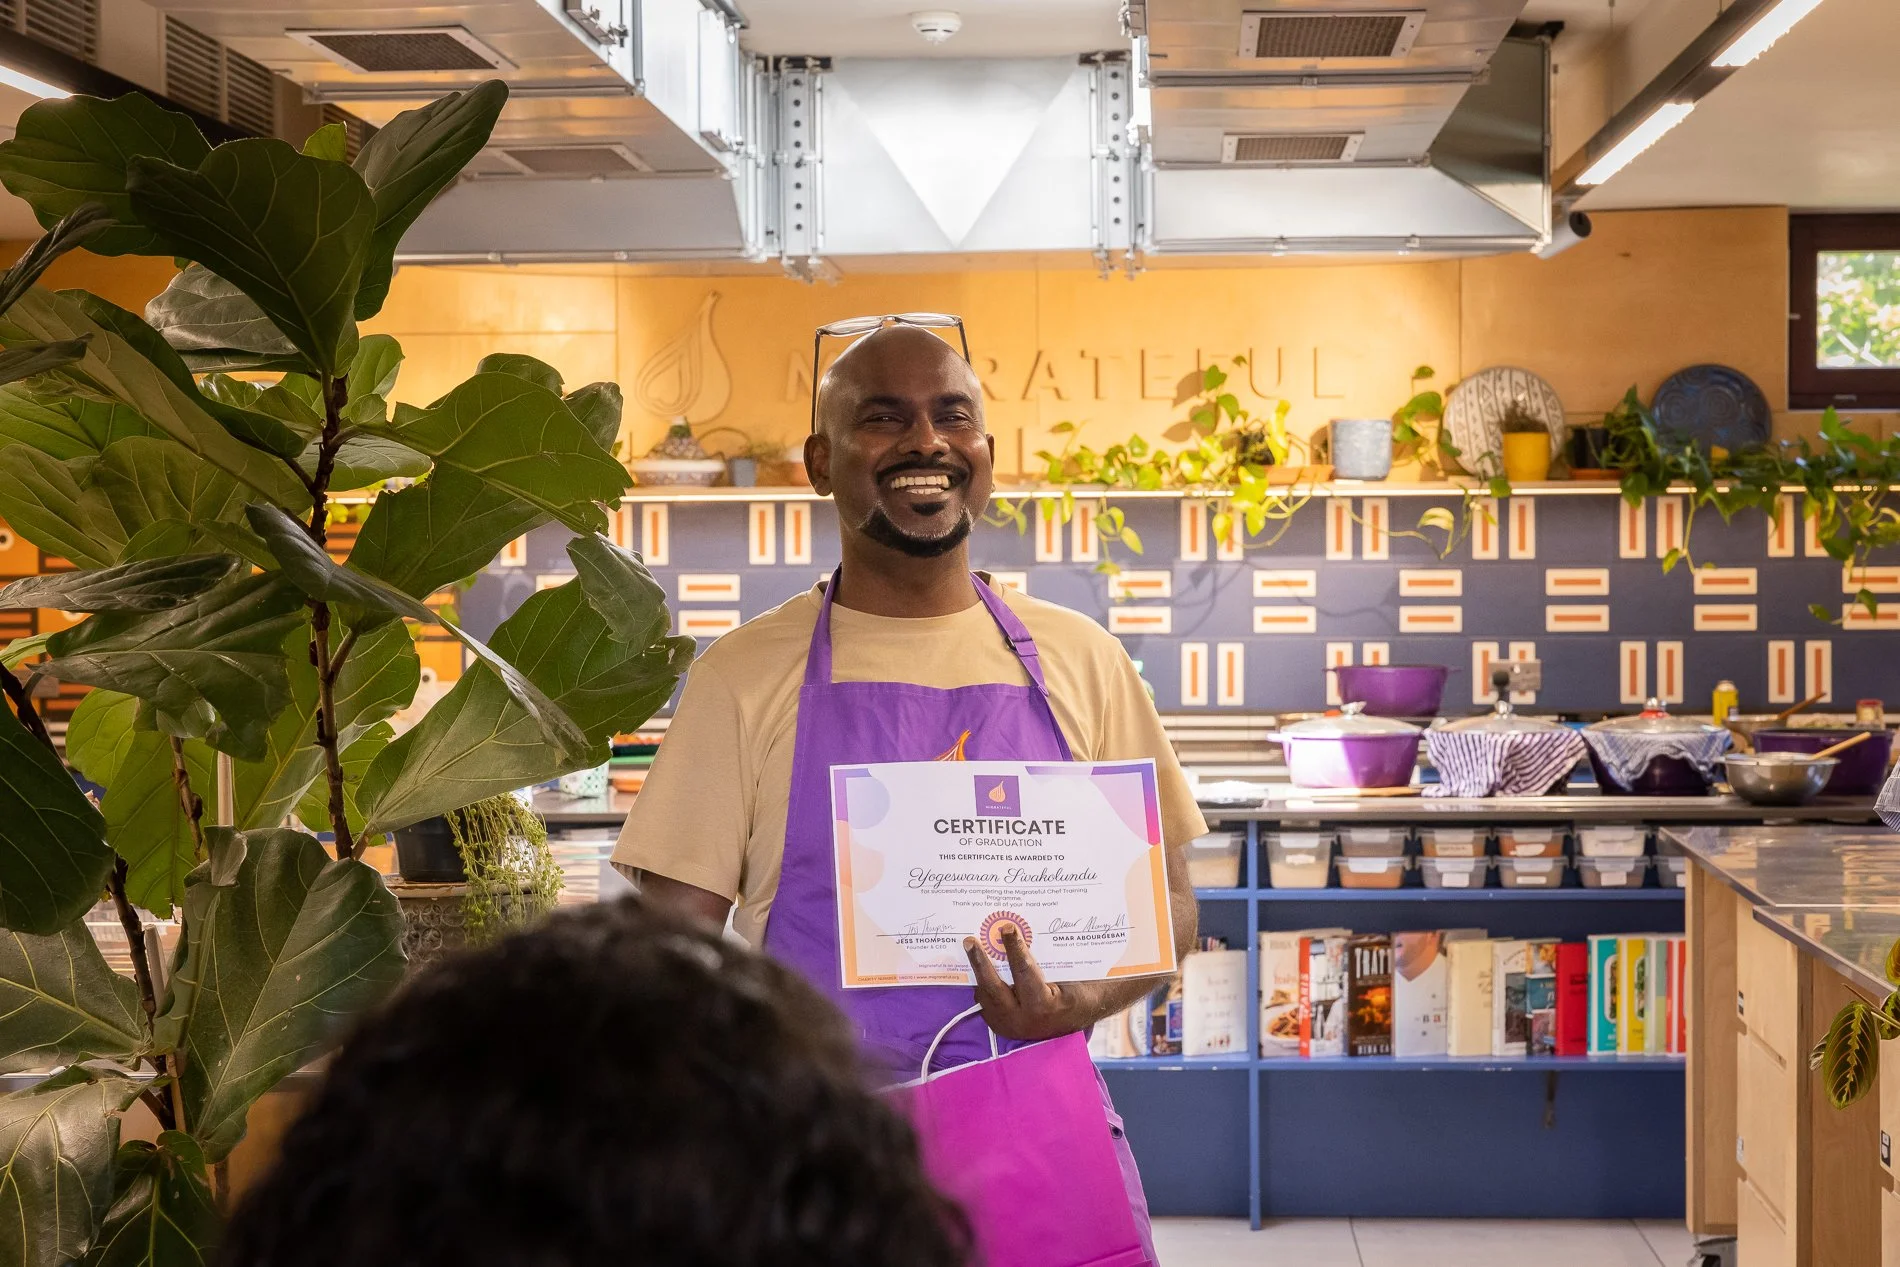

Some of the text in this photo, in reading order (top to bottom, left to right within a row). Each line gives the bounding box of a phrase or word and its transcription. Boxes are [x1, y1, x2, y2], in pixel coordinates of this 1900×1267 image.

[787, 347, 1345, 401] MRATEFUL
[933, 819, 1066, 835] CERTIFICATE
[959, 838, 1043, 847] OF GRADUATION
[908, 867, 1000, 889] Yogeswaran
[1014, 888, 1046, 896] Migrateful
[1063, 887, 1088, 895] Training
